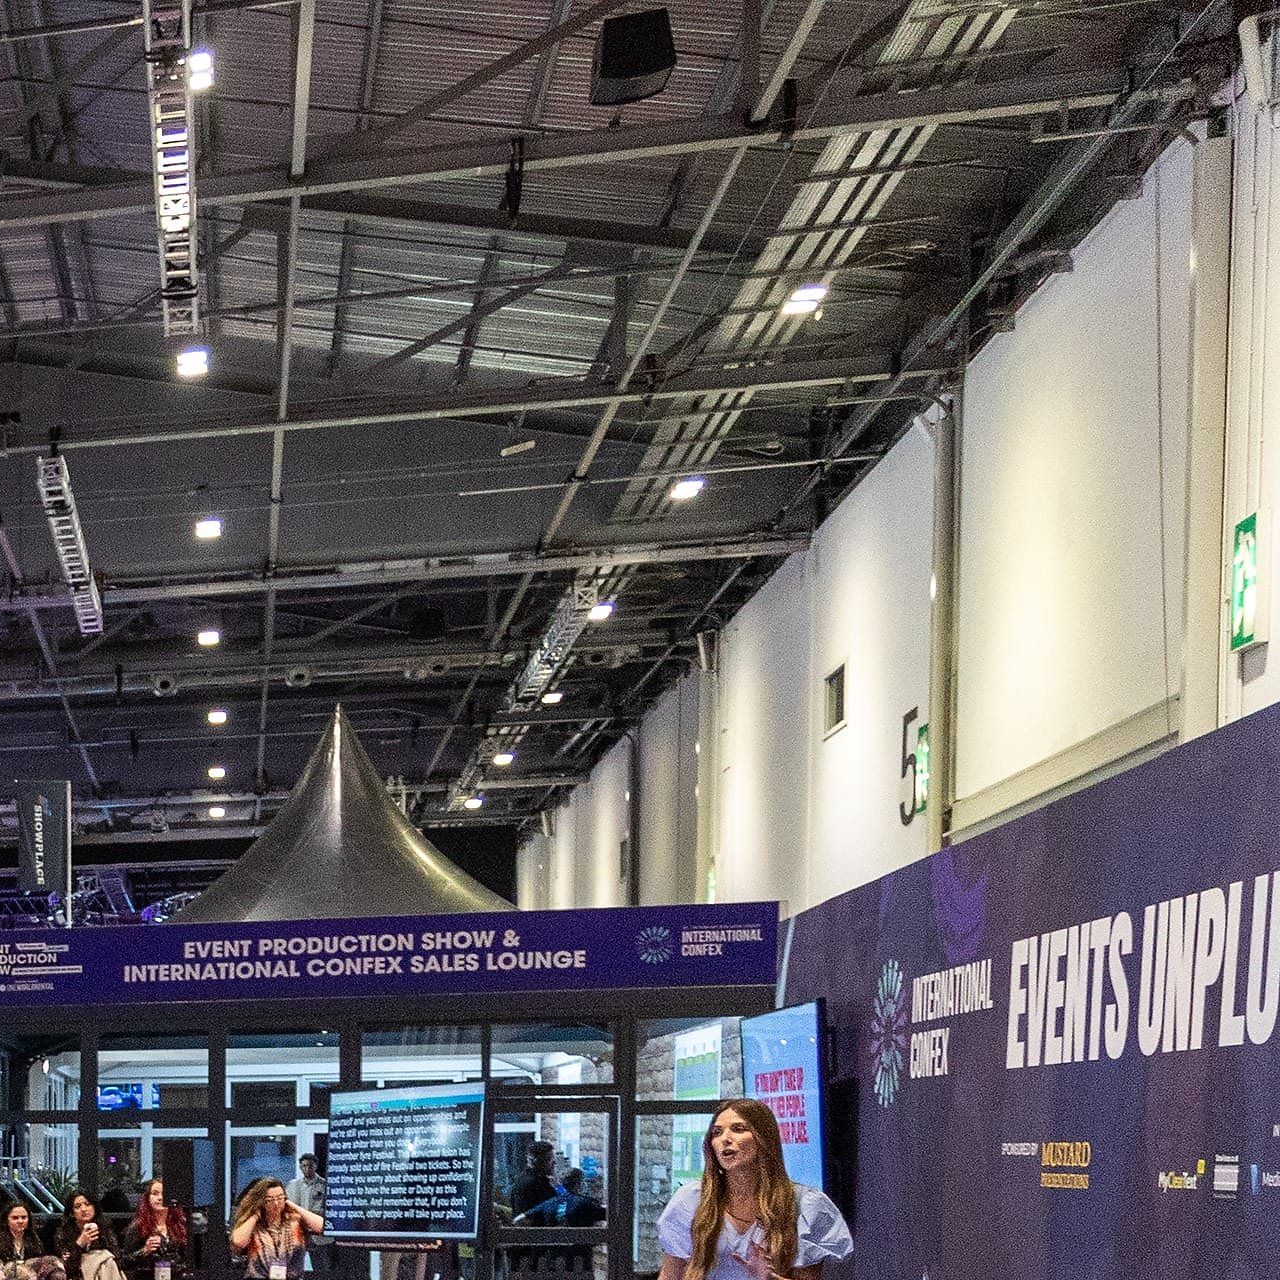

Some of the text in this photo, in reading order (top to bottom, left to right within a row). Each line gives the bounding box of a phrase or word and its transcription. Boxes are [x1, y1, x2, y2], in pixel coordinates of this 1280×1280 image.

[900, 706, 919, 827] 5
[34, 804, 46, 886] SHOWPLACE
[183, 929, 520, 959] EVENT PRODUCTION SHOW &
[681, 928, 763, 944] INTERNATIONAL
[681, 943, 723, 957] CONFEX
[123, 949, 587, 983] INTERNATIONAL CONFEX SALES LOUNGE
[911, 959, 993, 1024] INTERNATIONAL
[1005, 911, 1133, 1070] EVENTS
[910, 1027, 950, 1080] CONFEX
